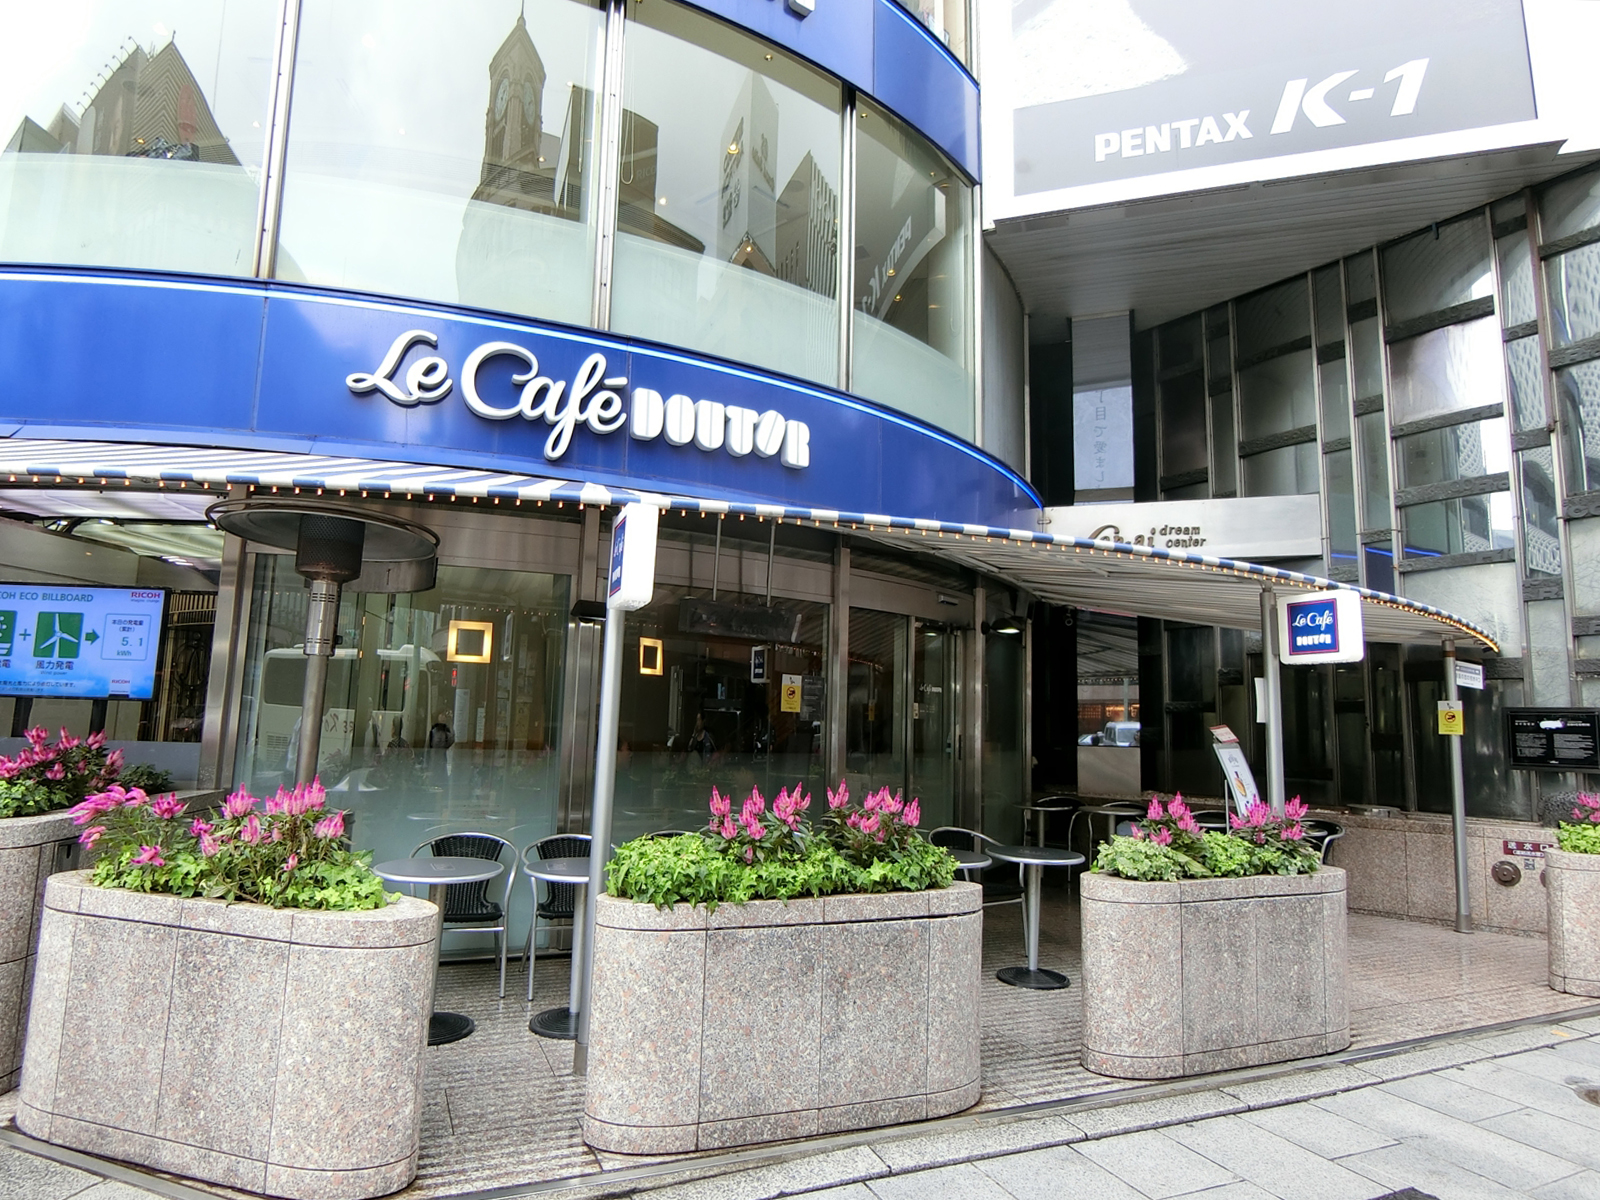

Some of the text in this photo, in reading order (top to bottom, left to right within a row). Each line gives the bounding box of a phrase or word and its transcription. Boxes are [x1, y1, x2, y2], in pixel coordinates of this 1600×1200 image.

[1094, 57, 1430, 162] PENTAX K-1
[345, 329, 811, 469] Le Café DOUTOR
[1159, 525, 1201, 536] dream
[1165, 536, 1207, 549] center
[19, 592, 39, 601] ECO
[42, 592, 94, 602] BILLBOARD
[130, 591, 161, 599] RICOH
[1292, 610, 1334, 631] Le Café
[35, 660, 75, 670] 風力発電
